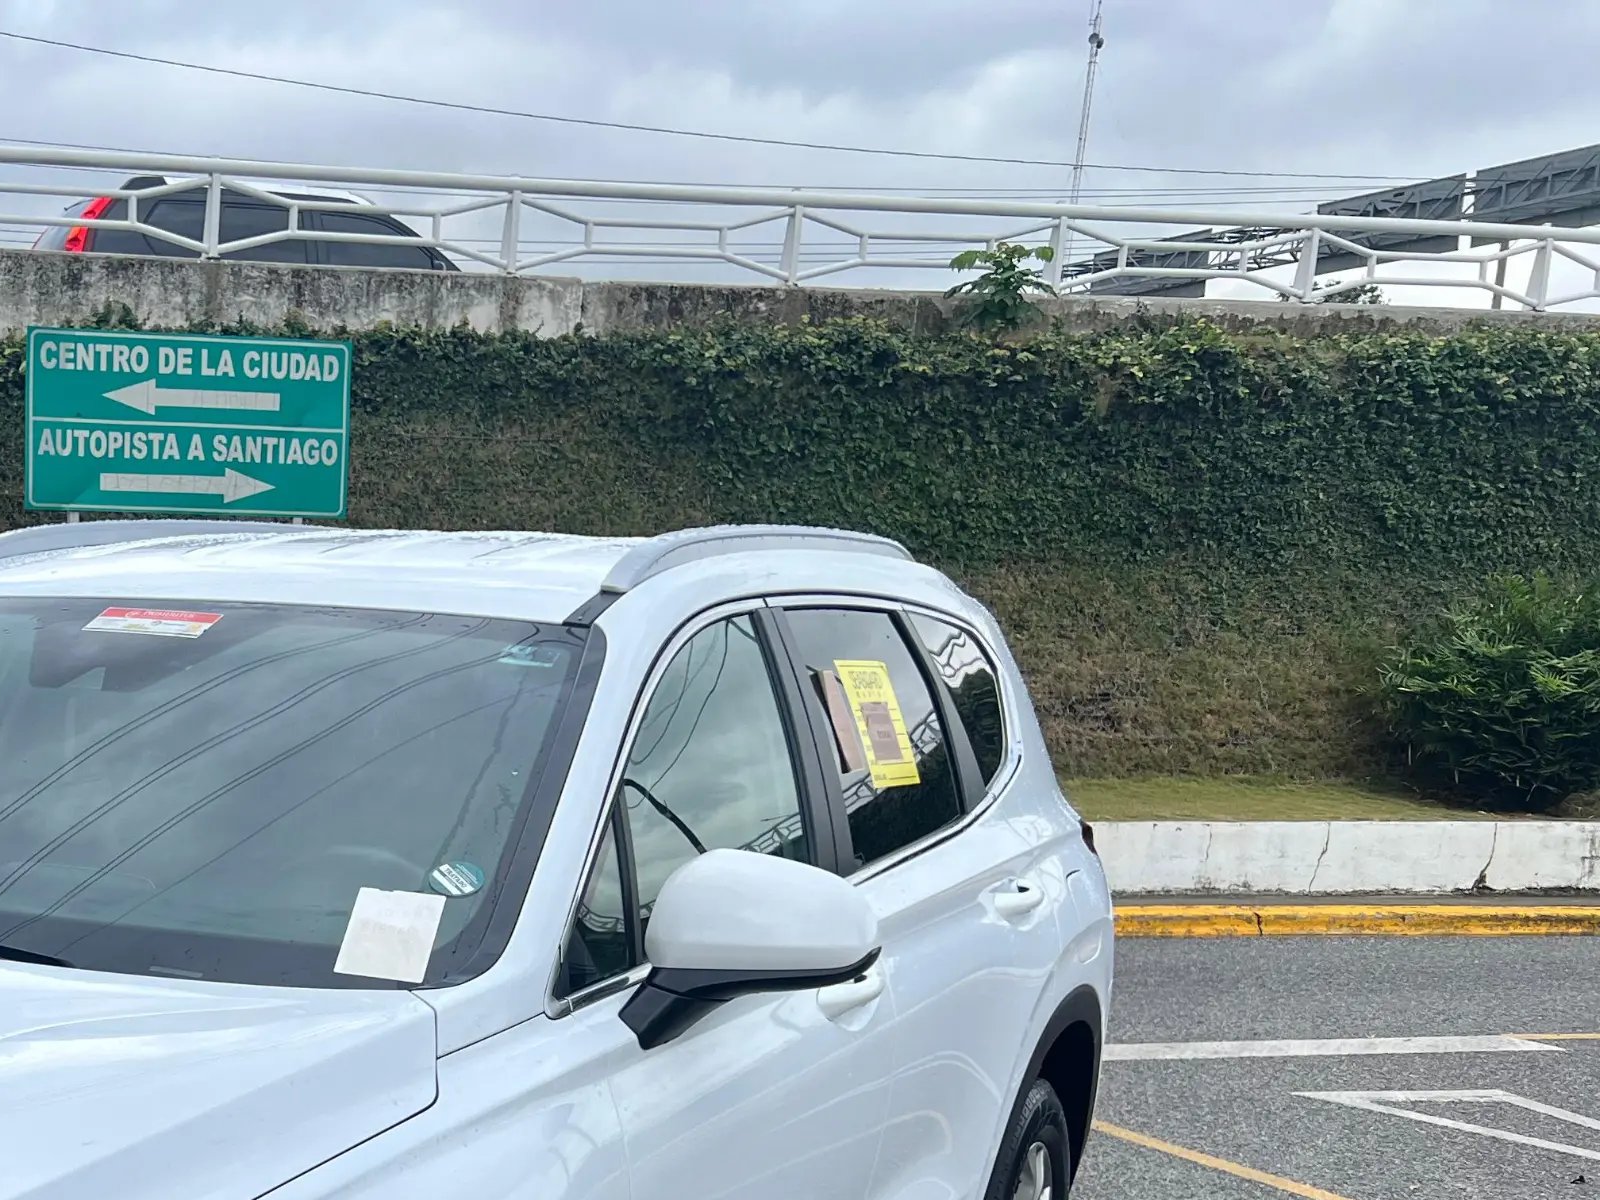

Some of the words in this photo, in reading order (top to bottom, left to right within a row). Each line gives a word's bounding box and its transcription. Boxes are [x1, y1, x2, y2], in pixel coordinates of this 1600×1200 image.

[40, 341, 148, 373] CENTRO
[159, 348, 192, 375] DE
[201, 349, 235, 377] LA
[243, 351, 339, 382] CIUDAD
[38, 429, 180, 460] AUTOPISTA
[187, 434, 205, 461] A
[213, 435, 338, 466] SANTIAGO
